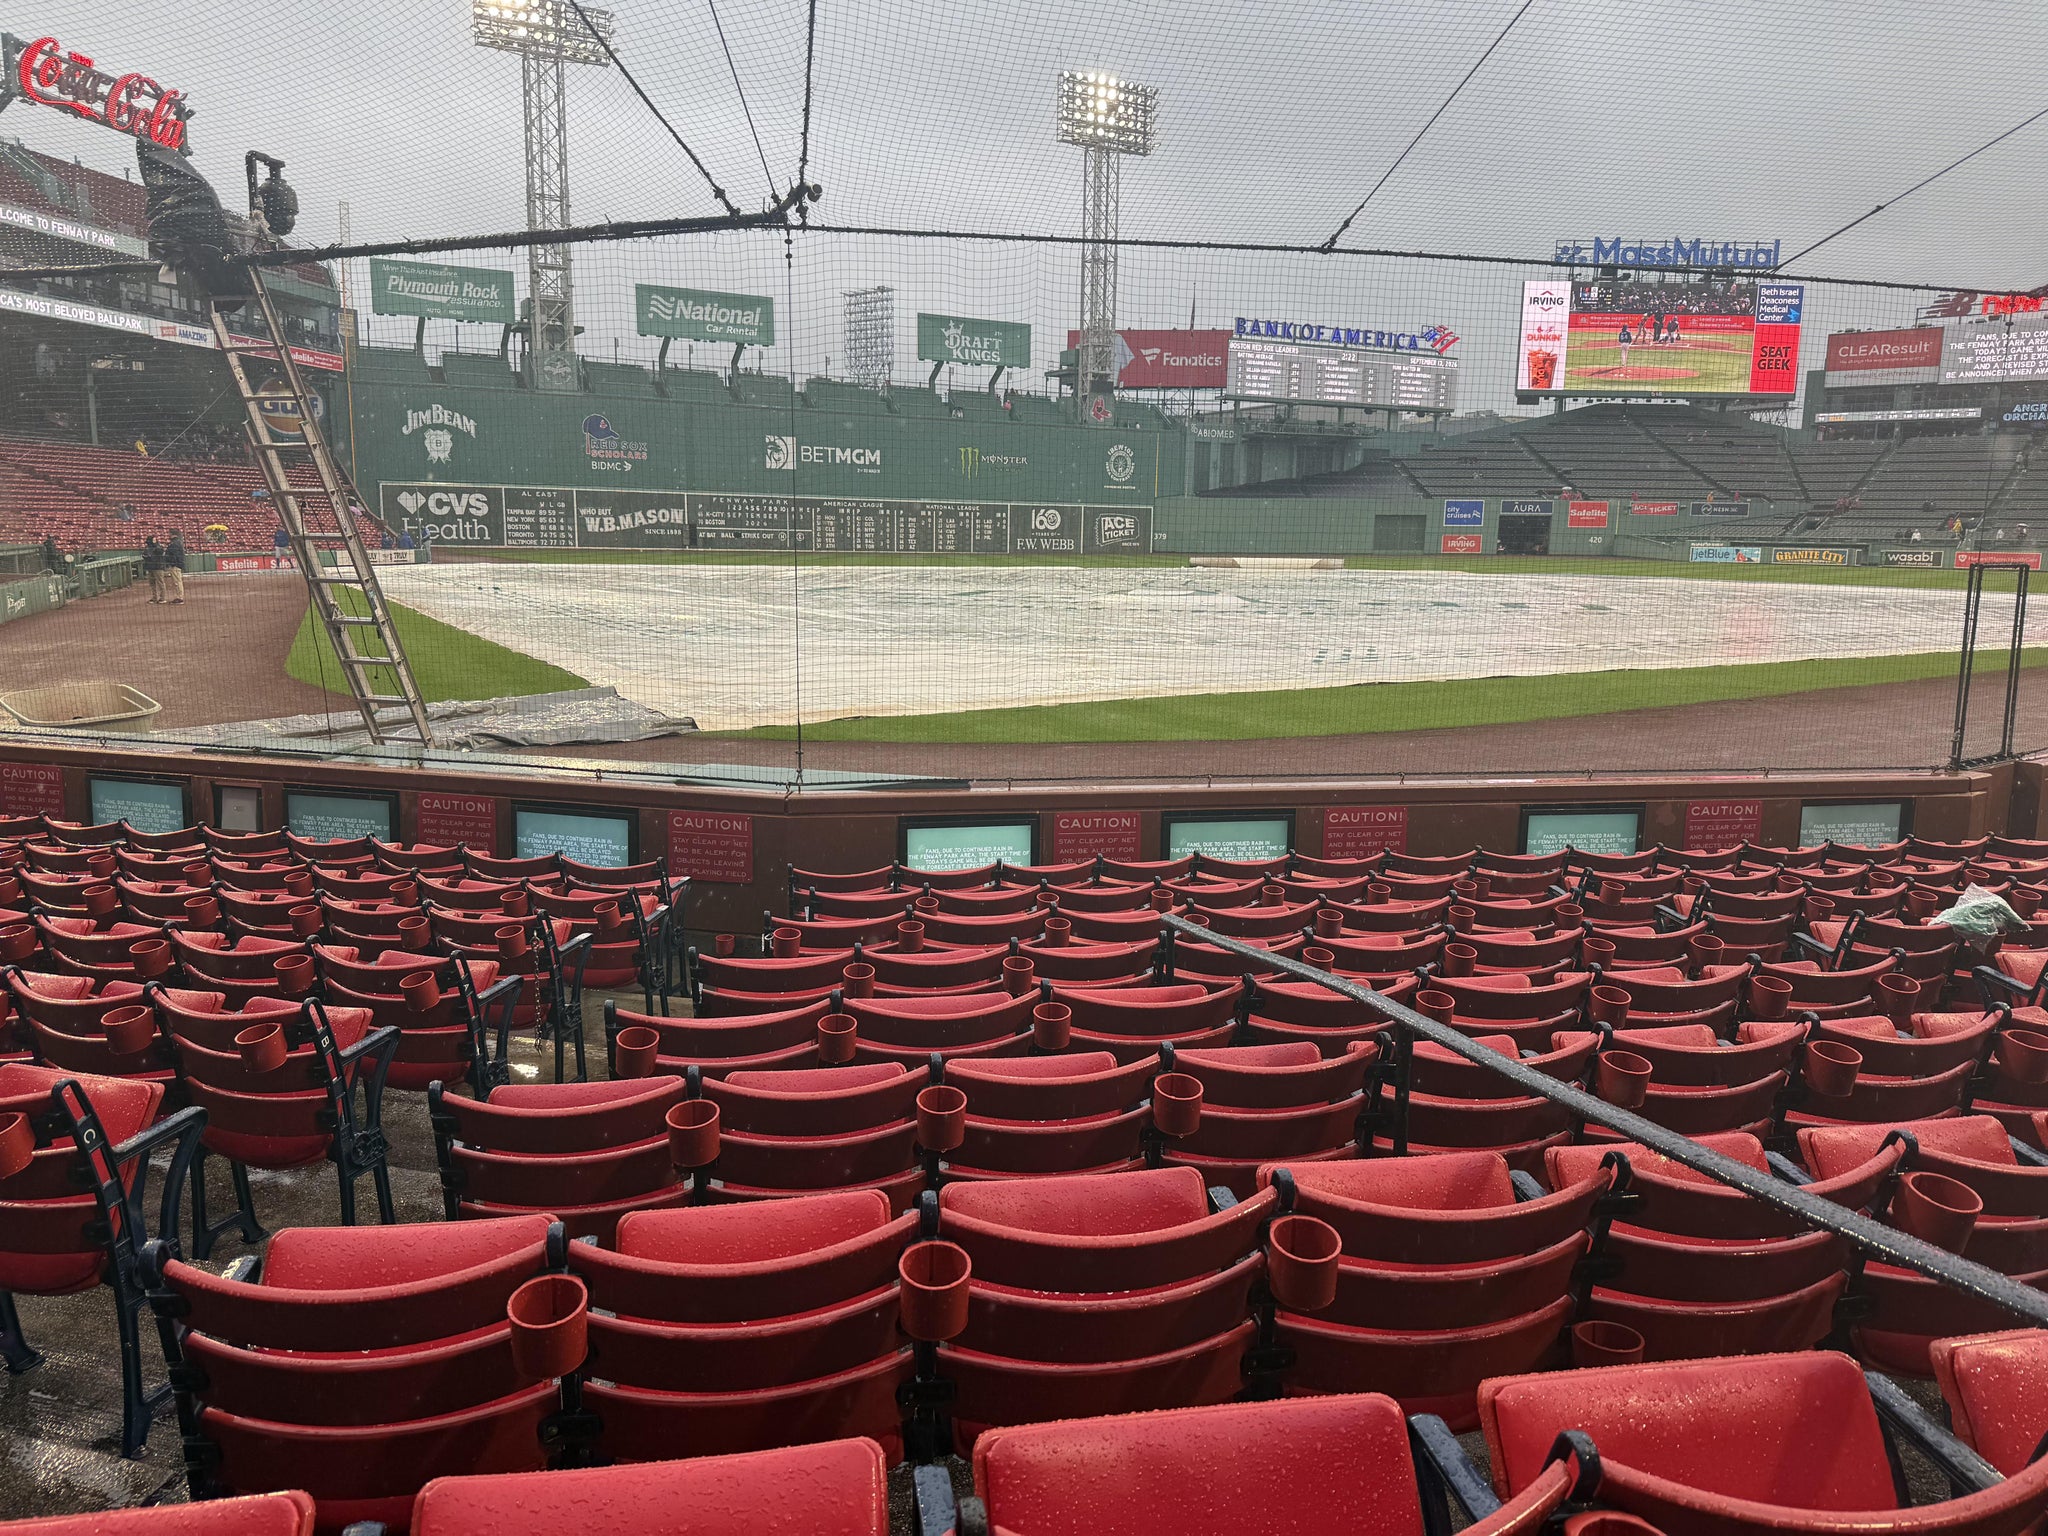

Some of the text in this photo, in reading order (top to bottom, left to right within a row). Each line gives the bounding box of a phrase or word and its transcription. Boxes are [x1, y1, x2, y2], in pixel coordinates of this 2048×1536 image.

[36, 216, 49, 230] TO
[51, 220, 90, 239] FENWAY
[91, 232, 115, 247] PARK
[1593, 236, 1780, 267] MassMutual
[387, 275, 500, 300] Plymouth Rock
[1761, 288, 1800, 296] Beth Israel
[1529, 296, 1564, 306] IRVING
[1760, 297, 1800, 305] Deaconess
[25, 299, 52, 314] MOST
[54, 304, 96, 321] BELOVED
[97, 312, 143, 330] BALLPARK
[675, 299, 762, 326] National
[1759, 305, 1789, 313] Medical
[1758, 314, 1784, 322] Center
[706, 323, 758, 337] Car Rental
[1235, 316, 1419, 351] BANK OF AMERICA
[945, 334, 1002, 350] DRAFT
[1976, 333, 1999, 342] FANS,
[2021, 331, 2031, 339] TO
[1839, 341, 1932, 358] CLEAResult
[1967, 341, 2000, 349] FENWAY
[952, 347, 1001, 362] KINGS
[1760, 345, 1791, 358] SEAT
[1974, 347, 2007, 356] TODAY'S
[1163, 351, 1222, 367] Fanatics
[1757, 359, 1791, 370] GEEK
[1973, 362, 1990, 370] AND
[1946, 371, 1956, 379] BE
[2009, 368, 2032, 376] WHEN
[401, 403, 478, 438] JIM BEAM
[1197, 428, 1236, 439] ABIOMED
[591, 439, 648, 451] RED SOX
[591, 450, 648, 460] SCHOLARS
[800, 446, 881, 466] BETMGM
[981, 454, 1028, 465] MONSTER
[591, 461, 622, 471] BIDMC
[428, 492, 489, 517] CVS
[1650, 505, 1678, 513] TICKET
[578, 507, 596, 516] WHO
[1447, 507, 1460, 515] city
[1570, 509, 1607, 517] Safelite
[1032, 508, 1061, 530] 160
[1104, 517, 1135, 530] ACE
[507, 523, 530, 531] BOSTON
[1105, 529, 1135, 539] TICKET
[1040, 538, 1075, 550] WEBB
[1588, 536, 1603, 544] 420
[1695, 547, 1730, 560] jetBlue
[1775, 550, 1846, 562] GRANITE CITY
[1888, 551, 1934, 563] wasabi
[221, 559, 259, 570] Safelite
[2, 768, 59, 781] CAUTION!
[422, 798, 491, 813] CAUTION!
[1691, 805, 1759, 816] CAUTION!
[1328, 811, 1403, 823] CAUTION!
[1059, 817, 1137, 829] CAUTION!
[731, 850, 747, 858] FOR
[676, 857, 711, 865] OBJECTS
[693, 868, 722, 876] PLAYING
[82, 1128, 96, 1144] C
